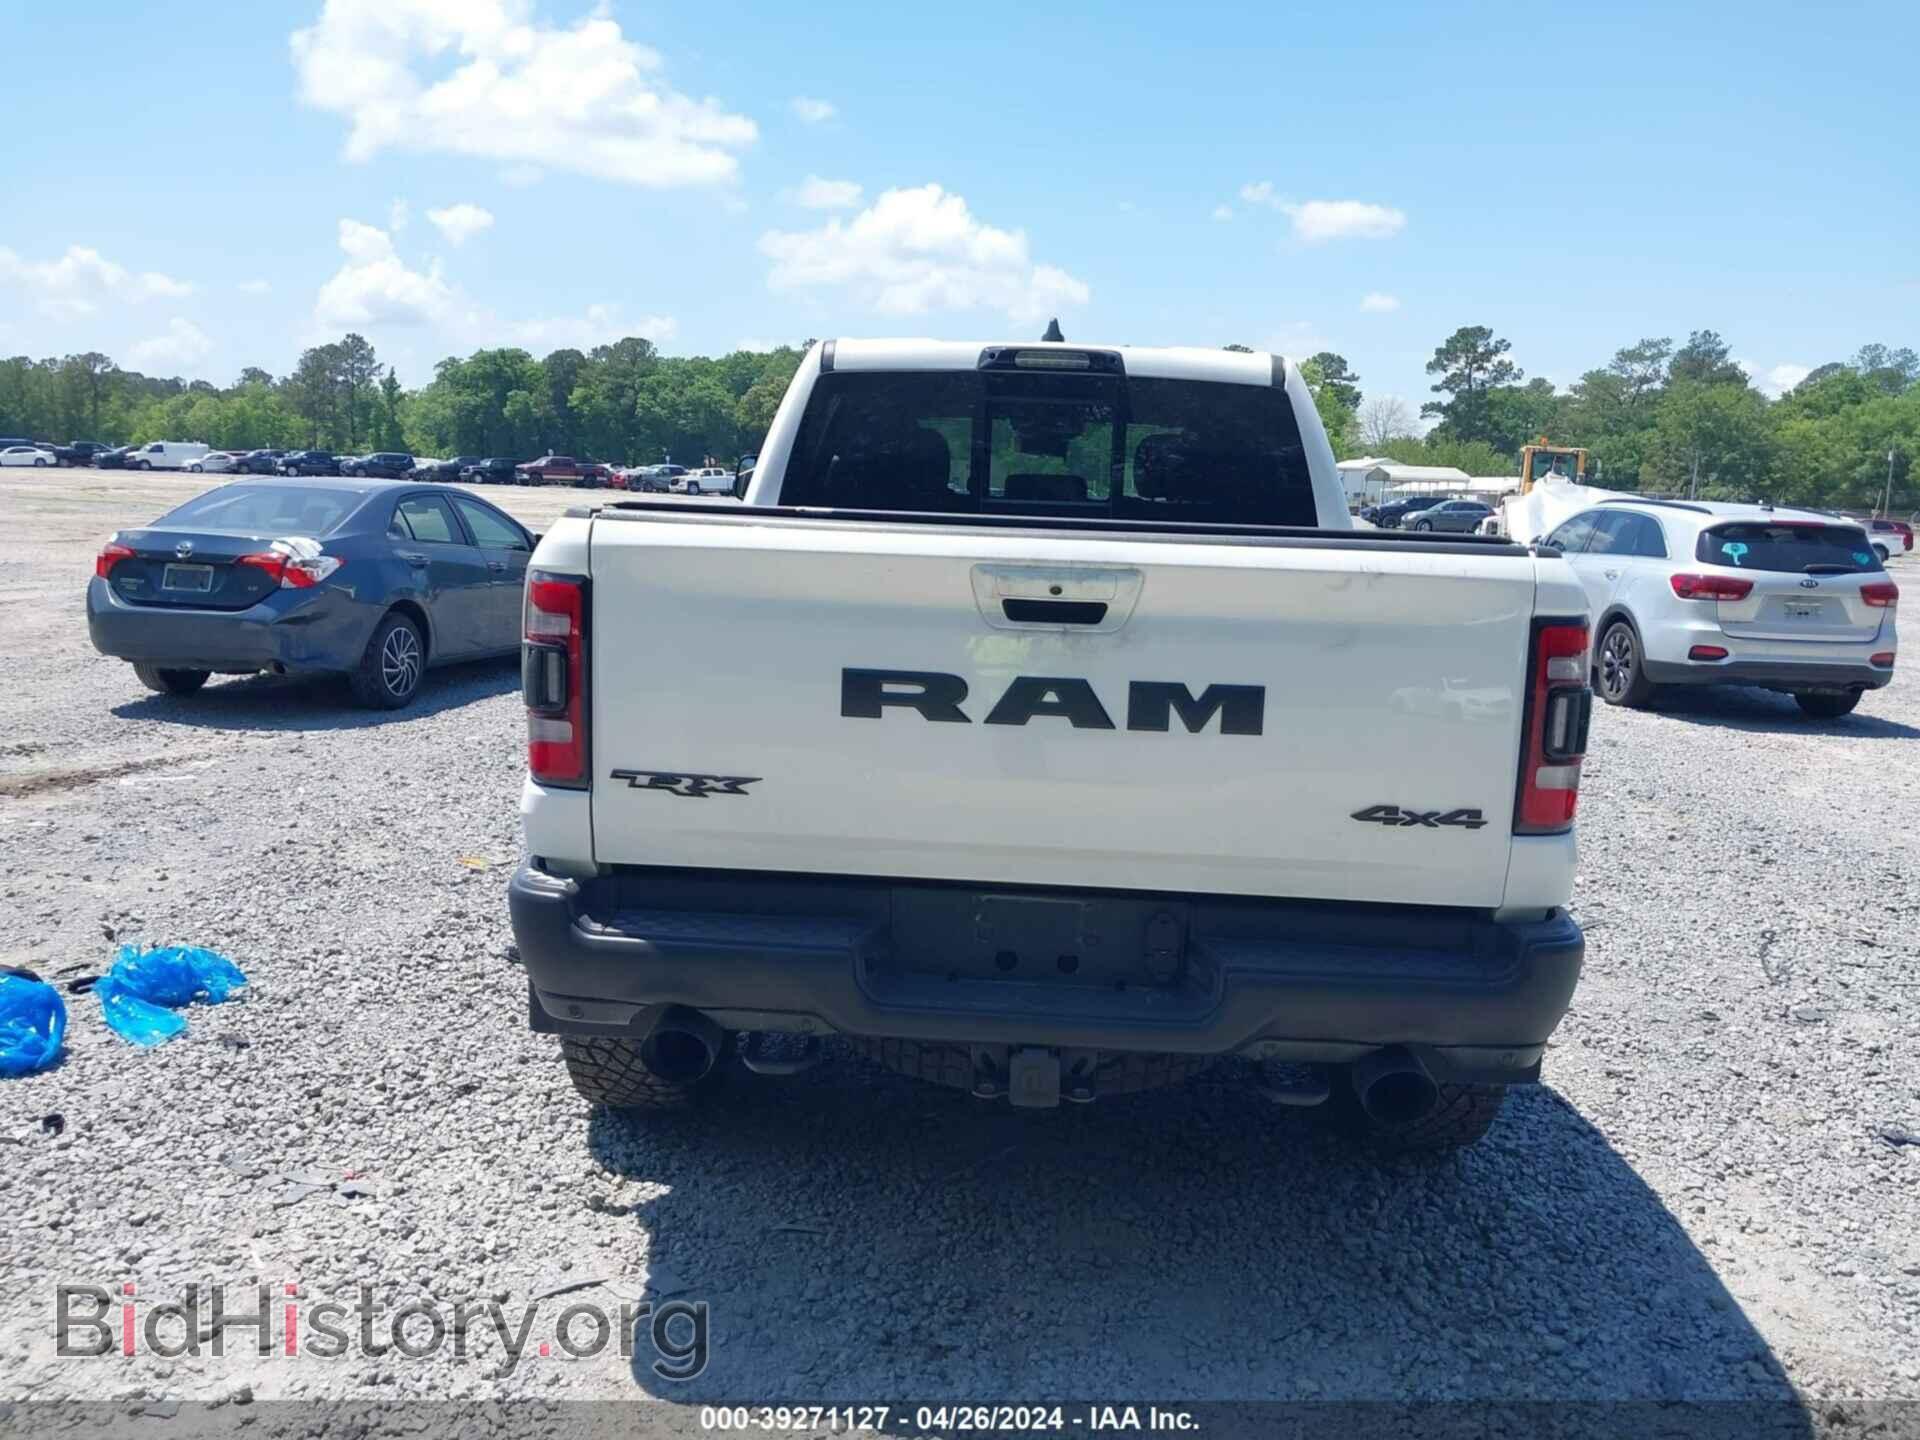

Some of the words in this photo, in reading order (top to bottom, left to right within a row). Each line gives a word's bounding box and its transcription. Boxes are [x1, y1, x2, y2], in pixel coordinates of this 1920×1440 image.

[841, 668, 1264, 735] RAM
[610, 769, 762, 797] TRX
[1351, 804, 1488, 829] 4x4
